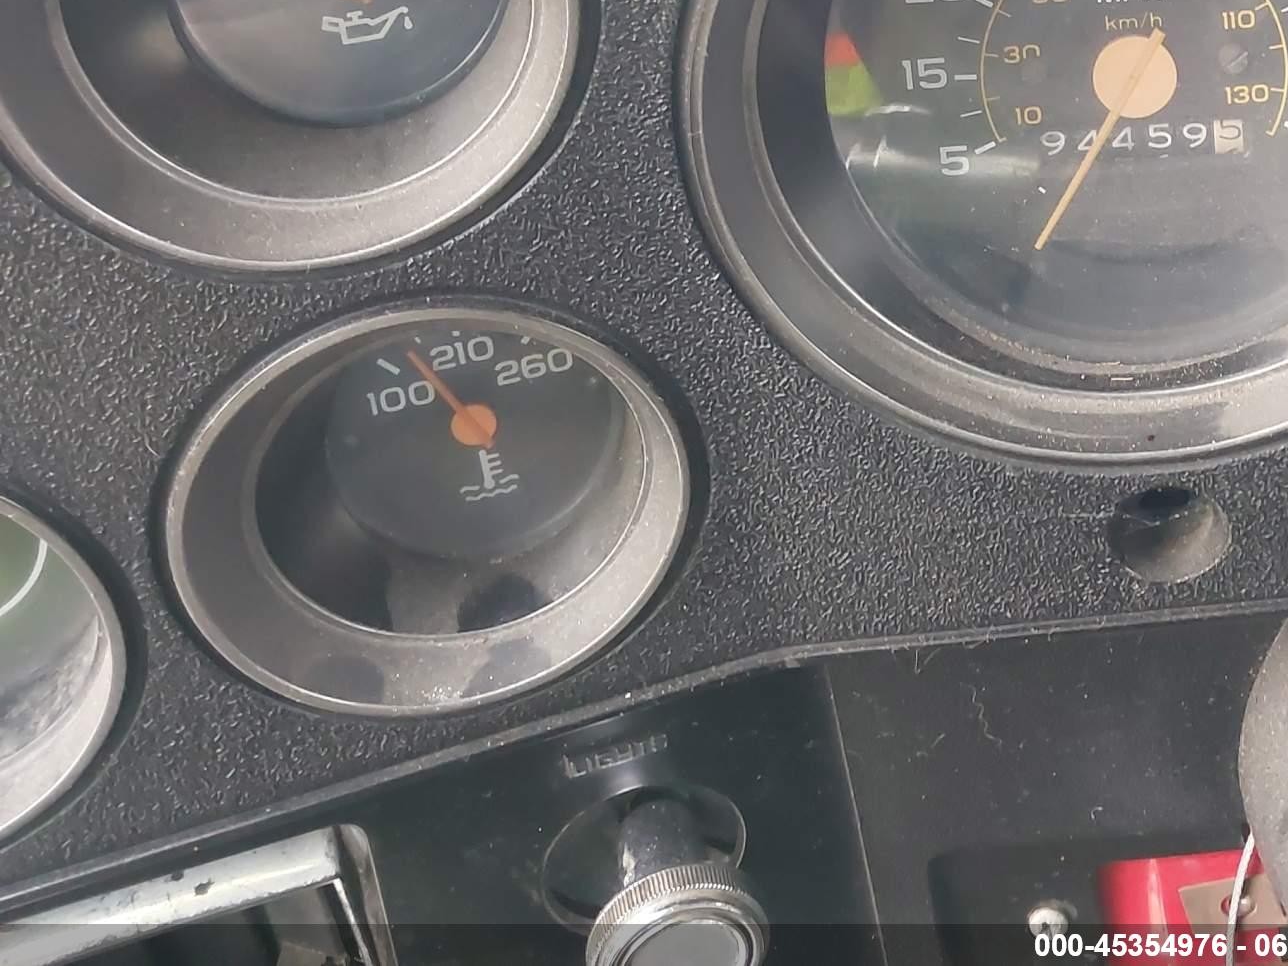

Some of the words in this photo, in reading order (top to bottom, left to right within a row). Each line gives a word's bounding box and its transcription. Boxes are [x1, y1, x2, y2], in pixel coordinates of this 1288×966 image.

[1104, 12, 1163, 31] km/h
[1222, 10, 1256, 30] 110
[901, 57, 948, 91] 15
[1224, 84, 1269, 105] 130
[1015, 106, 1042, 125] 10
[939, 146, 970, 176] 5
[429, 336, 495, 371] 210
[494, 348, 574, 386] 260
[366, 380, 435, 416] 100
